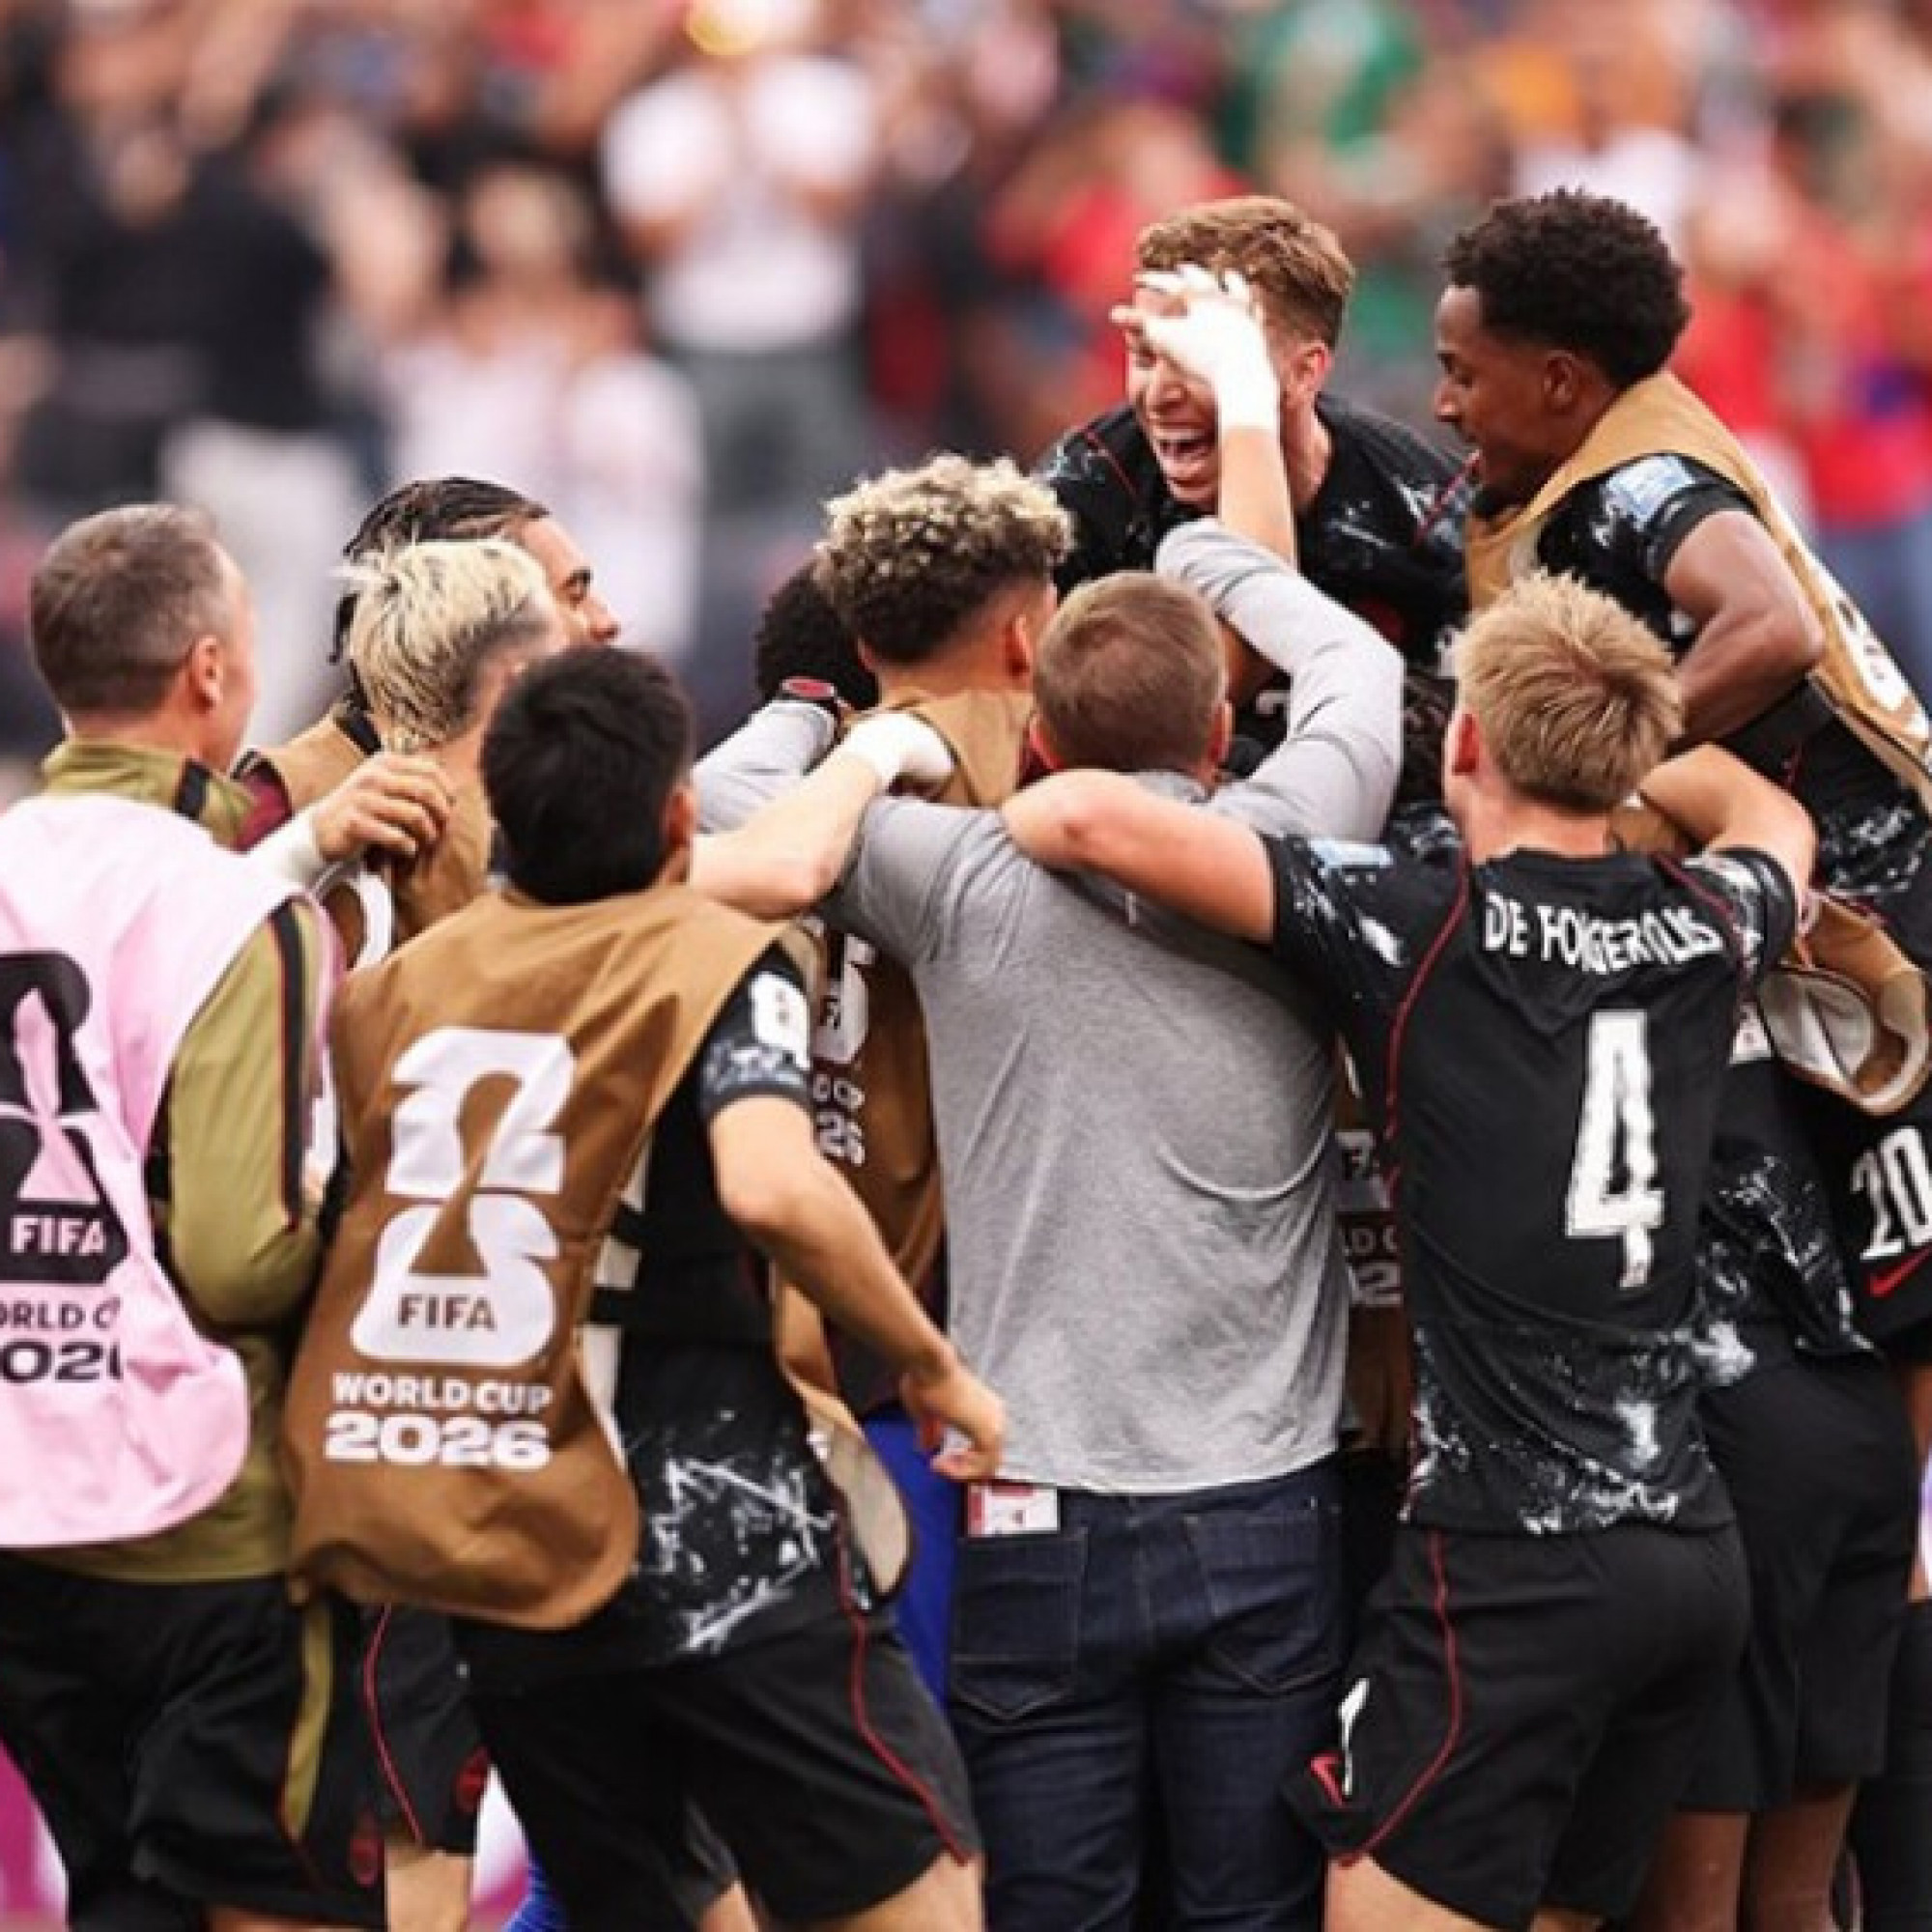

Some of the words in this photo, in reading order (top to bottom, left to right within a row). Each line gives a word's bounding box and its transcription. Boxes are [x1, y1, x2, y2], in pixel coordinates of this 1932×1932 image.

[1485, 891, 1528, 955] DE
[1565, 1009, 1664, 1288] 4
[1850, 1125, 1932, 1262] 20
[10, 1214, 107, 1256] FIFA
[397, 1293, 497, 1331] FIFA
[332, 1372, 471, 1410] WORLD
[474, 1379, 554, 1415] CUP
[324, 1409, 553, 1472] 2026
